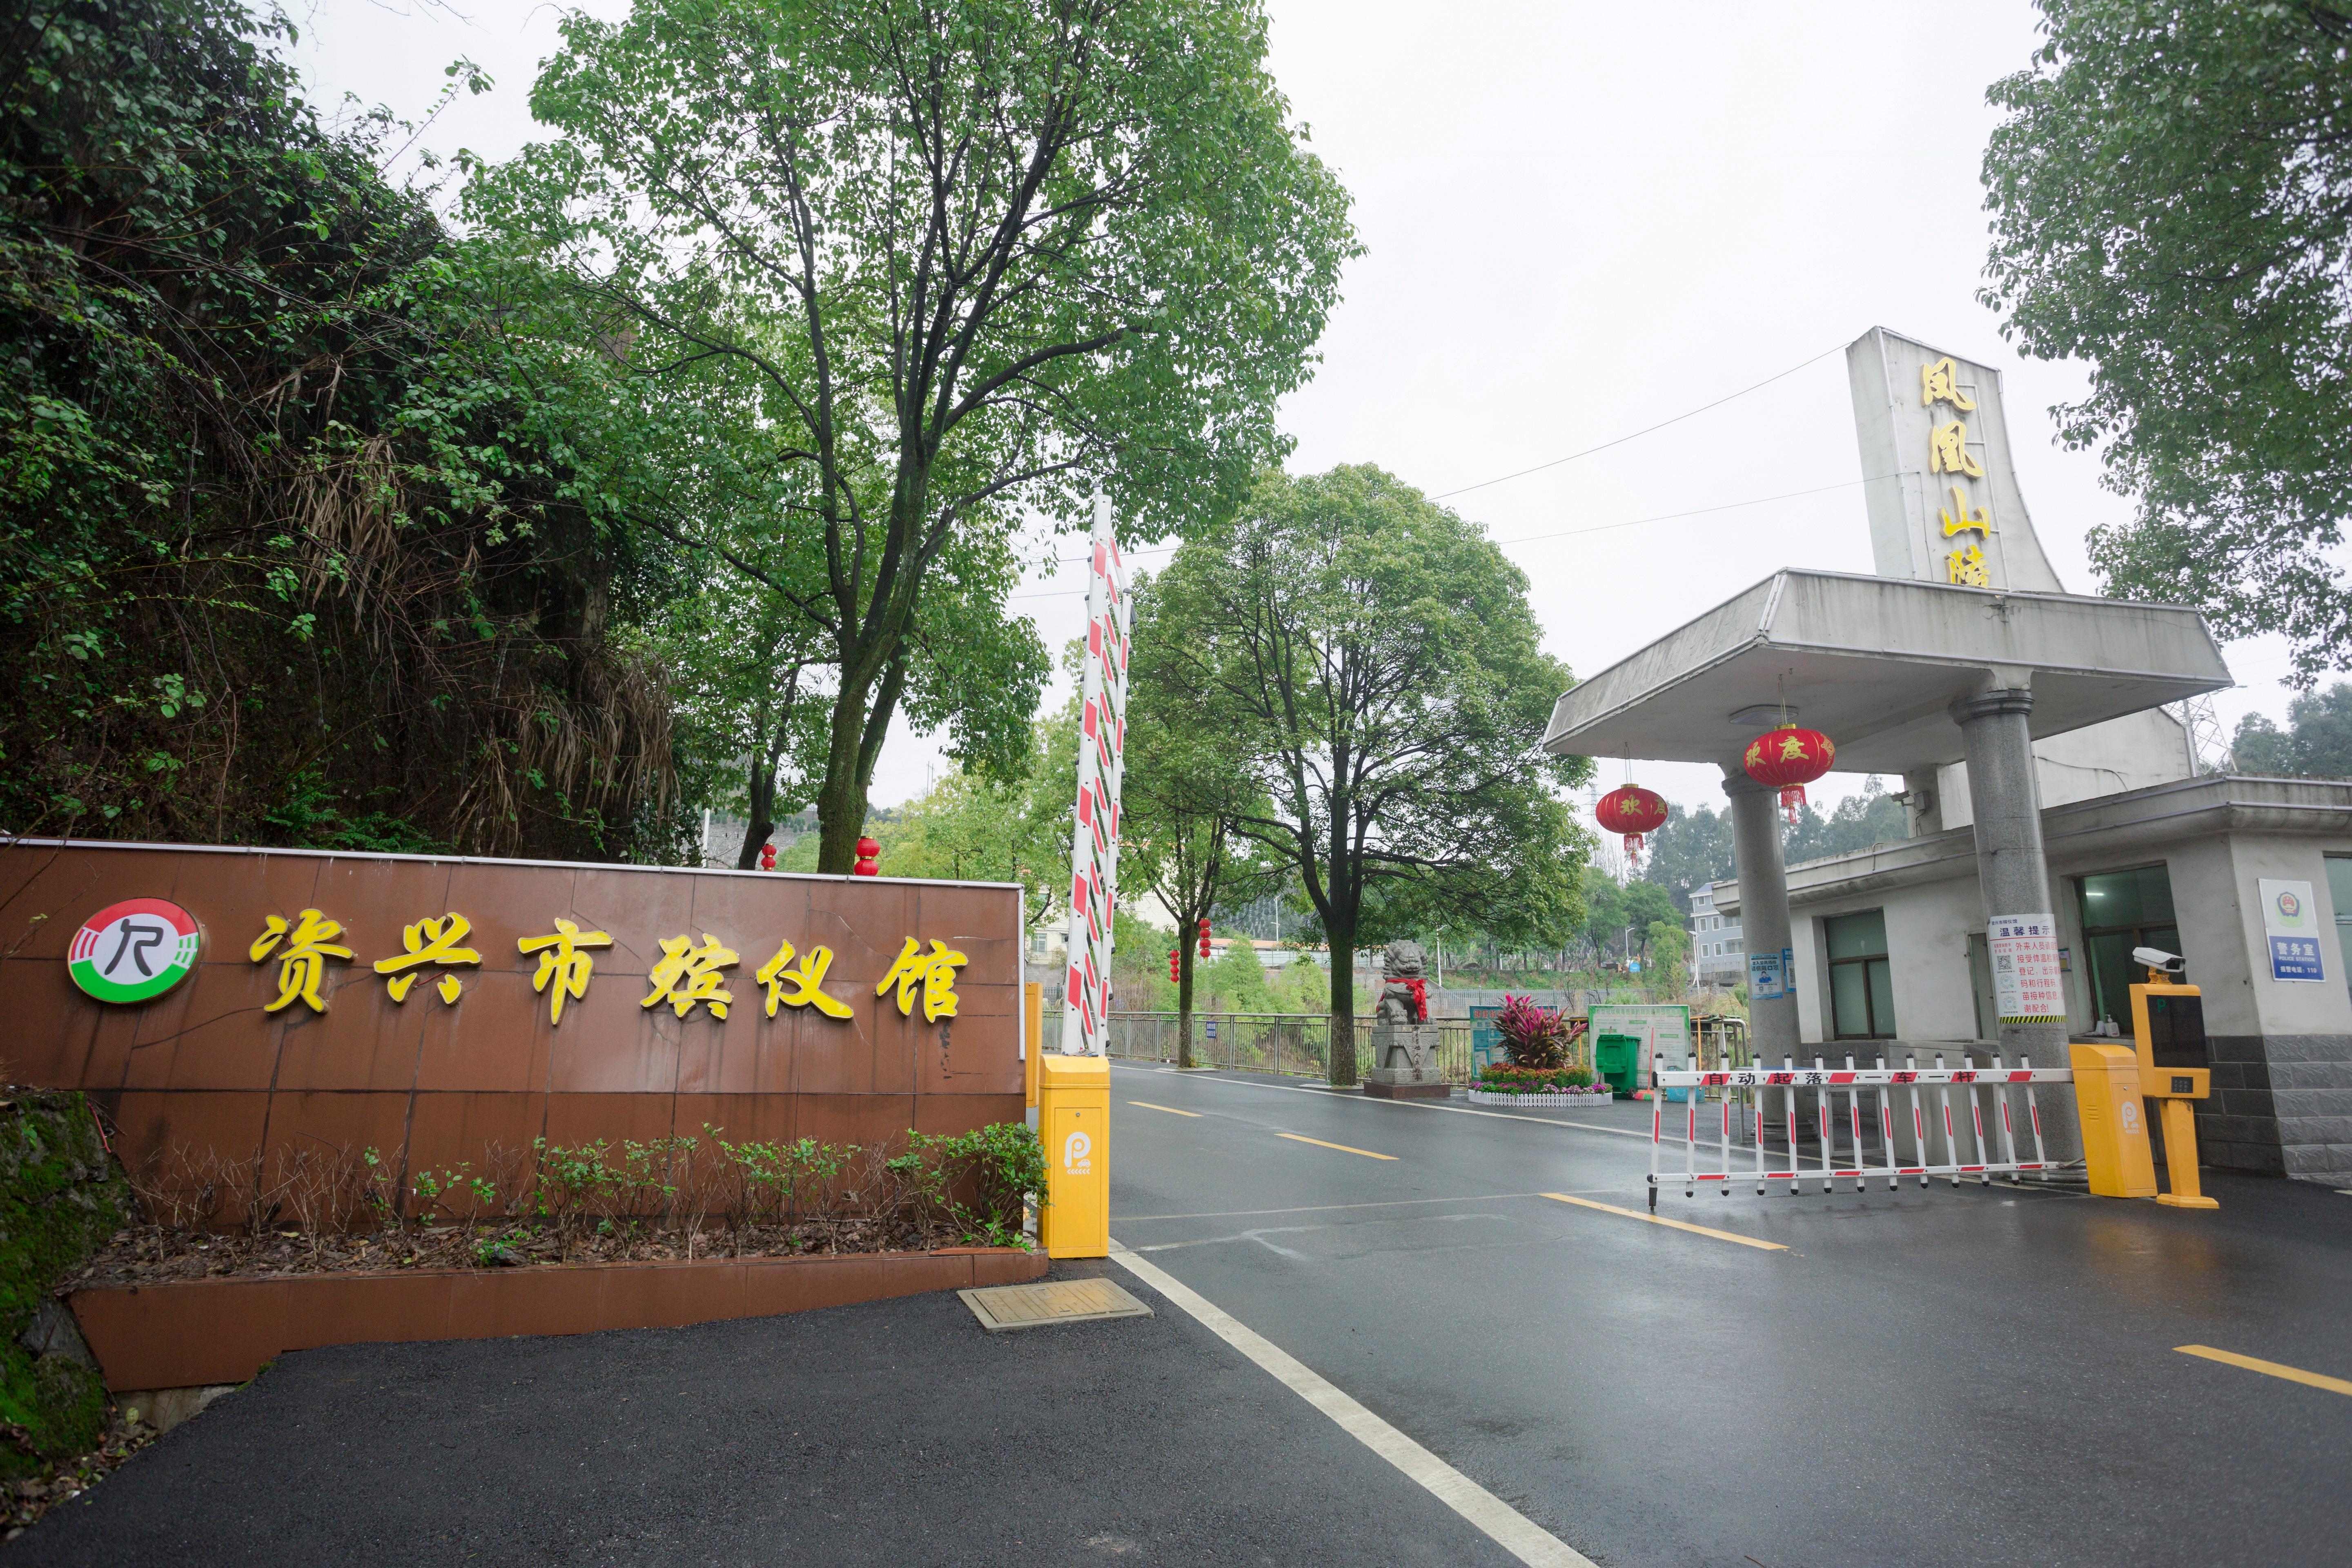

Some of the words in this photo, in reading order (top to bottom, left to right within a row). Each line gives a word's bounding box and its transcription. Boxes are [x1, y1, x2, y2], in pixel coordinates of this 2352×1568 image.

[2000, 926, 2050, 937] 温馨提示
[2276, 942, 2315, 956] 警务室
[250, 908, 969, 1026] 资兴市殡仪馆
[1708, 1072, 1822, 1086] 自动起落
[1865, 1071, 1973, 1084] 一车一杆
